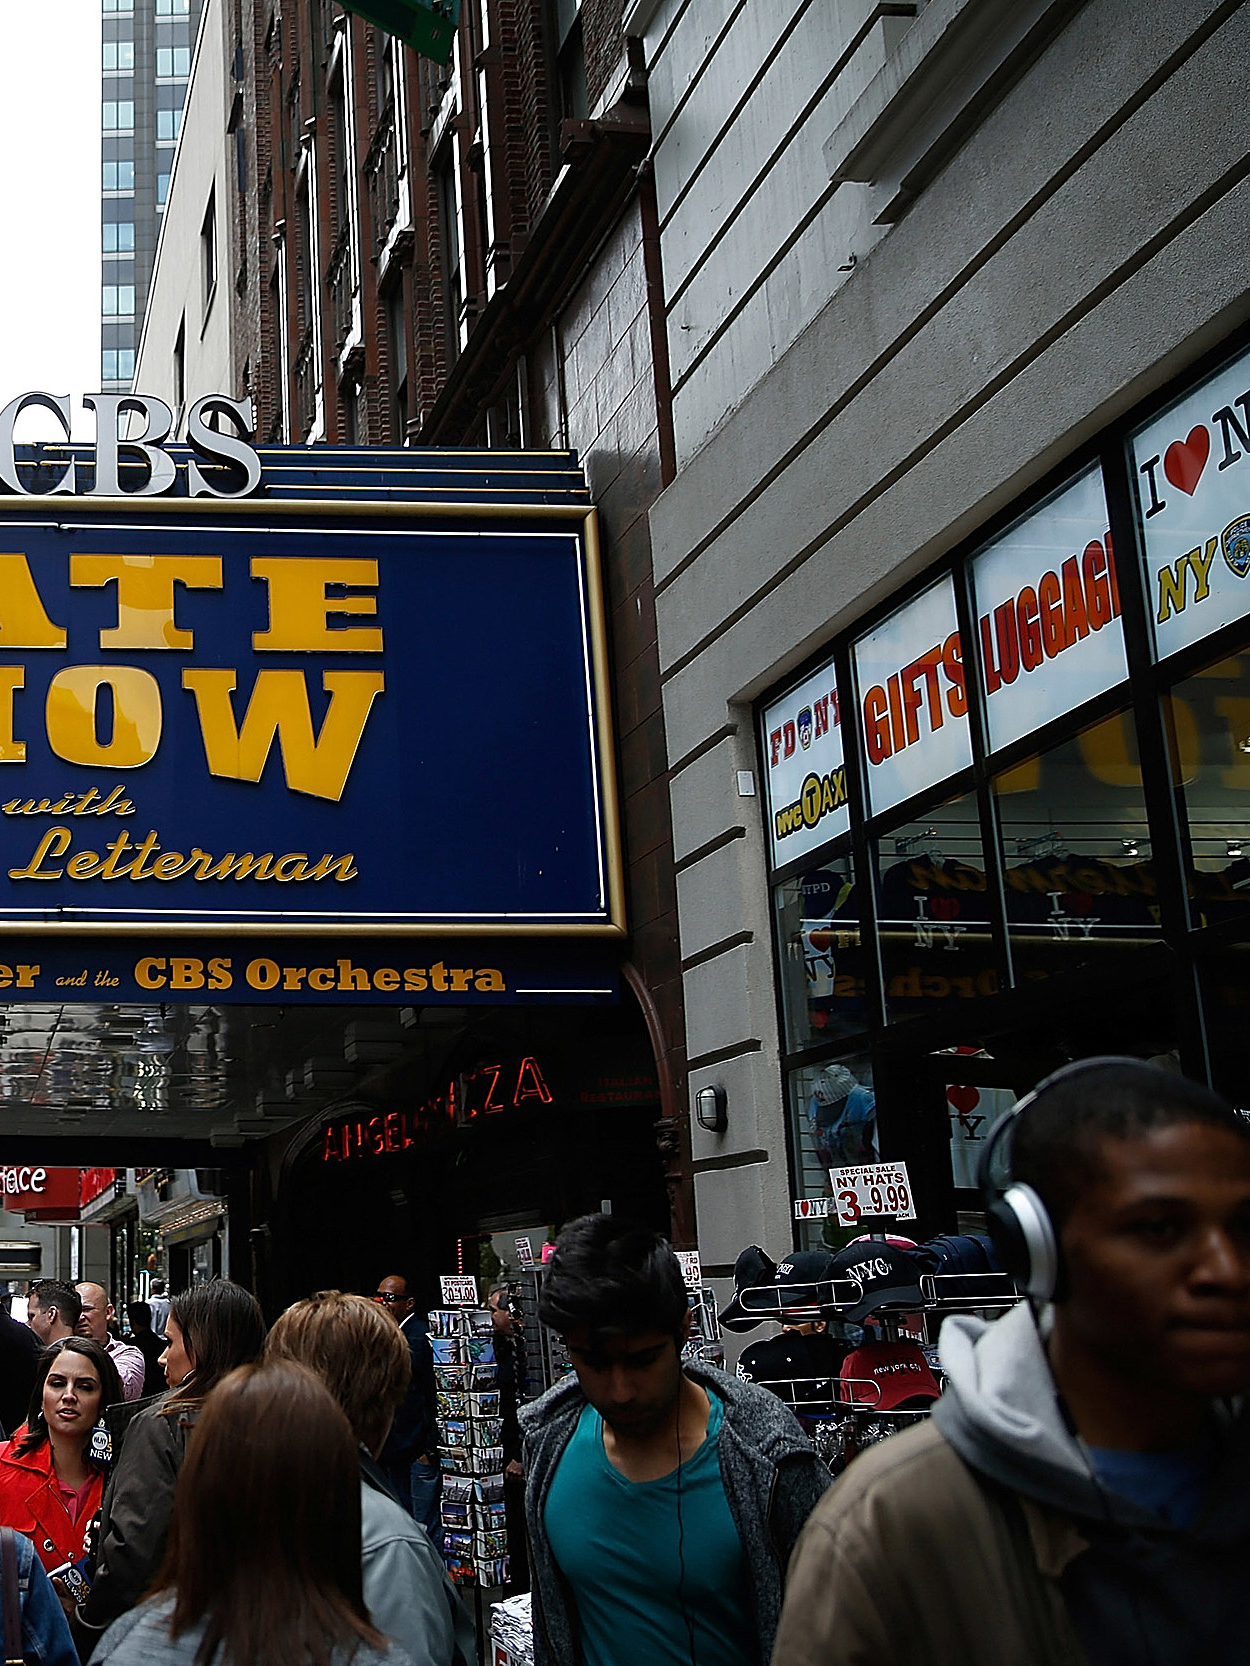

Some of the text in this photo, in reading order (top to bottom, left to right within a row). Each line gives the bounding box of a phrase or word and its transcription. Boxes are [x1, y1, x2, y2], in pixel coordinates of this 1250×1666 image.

[863, 632, 968, 765] GIFTS
[1, 785, 136, 815] with
[8, 826, 358, 881] Letterman
[54, 970, 87, 987] and
[93, 969, 120, 987] the
[134, 957, 233, 990] CBS
[245, 958, 506, 991] Orchestra
[836, 1173, 904, 1188] NY HATS
[840, 1165, 896, 1176] SPECIAL SALE
[838, 1190, 861, 1221] 3
[870, 1185, 910, 1213] 9.99
